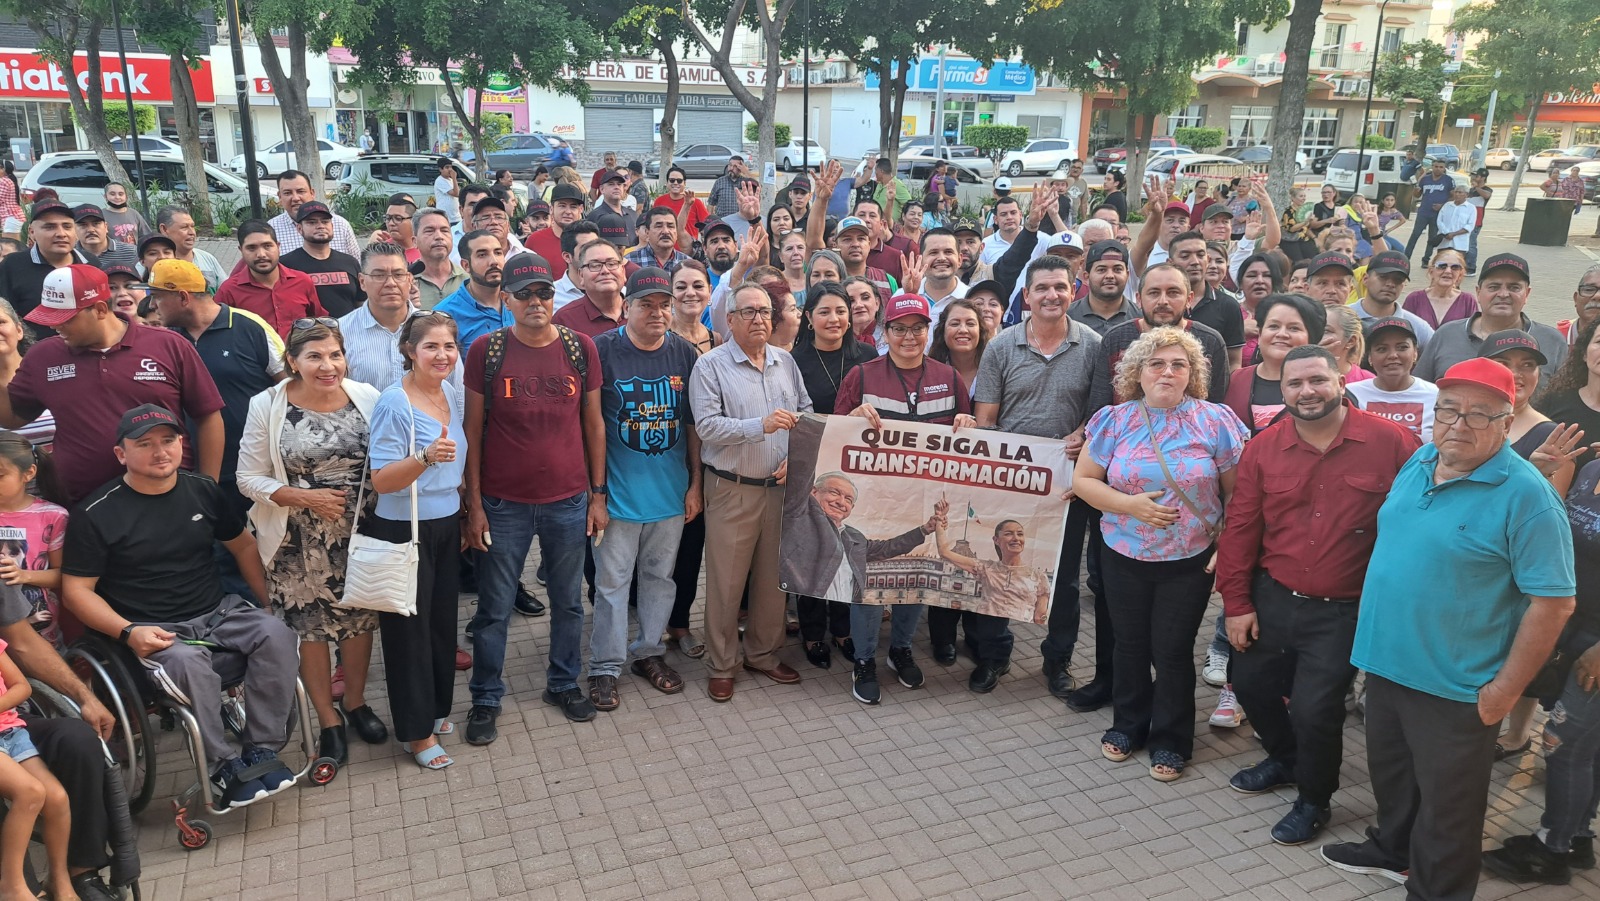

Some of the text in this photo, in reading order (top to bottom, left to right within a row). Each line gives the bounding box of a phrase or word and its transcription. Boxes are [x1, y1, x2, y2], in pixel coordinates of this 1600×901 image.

[635, 66, 653, 79] DE
[624, 94, 662, 104] GARCIA
[1316, 256, 1347, 266] morena
[1489, 259, 1524, 270] morena
[513, 265, 548, 276] morena
[637, 276, 669, 286] morena
[1372, 319, 1407, 331] morena
[1496, 337, 1537, 350] morena
[504, 375, 576, 398] BOSS
[638, 403, 669, 416] Qatar
[131, 411, 173, 424] morena
[1373, 412, 1416, 421] UGO
[861, 428, 1033, 463] QUE SIGA LA
[848, 450, 1047, 493] TRANSFORMACIÓN
